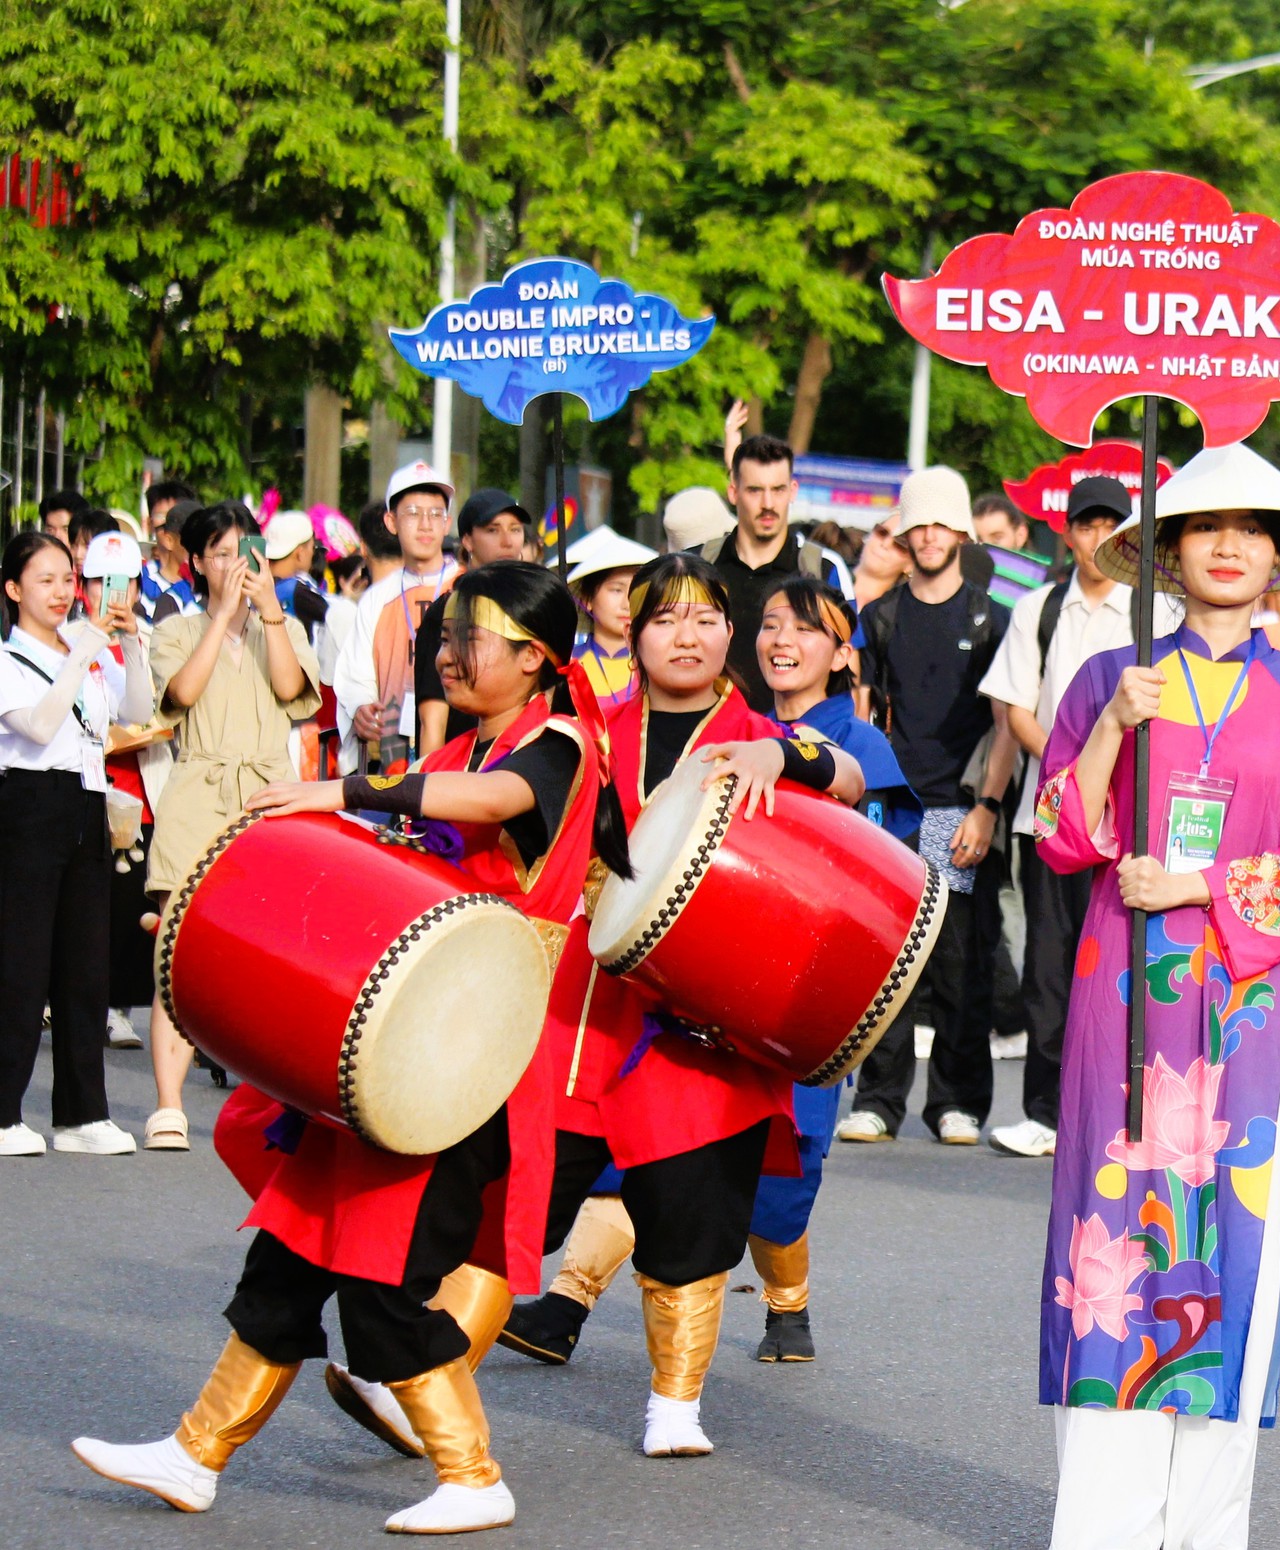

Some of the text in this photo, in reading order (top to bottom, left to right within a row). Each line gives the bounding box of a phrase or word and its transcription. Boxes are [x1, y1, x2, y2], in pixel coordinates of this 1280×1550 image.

[1039, 217, 1258, 247] ĐOÀN NGHỆ THUẬT
[1081, 246, 1221, 270] MÚA TRỐNG
[518, 277, 579, 301] ĐOÀN
[447, 309, 546, 333] DOUBLE
[551, 304, 634, 328] IMPRO
[935, 288, 1065, 334] EISA
[1083, 309, 1103, 320] -
[416, 329, 692, 362] WALLONIE BRUXELLES
[1022, 353, 1140, 377] (OKINAWA
[1162, 353, 1227, 380] NHẬT
